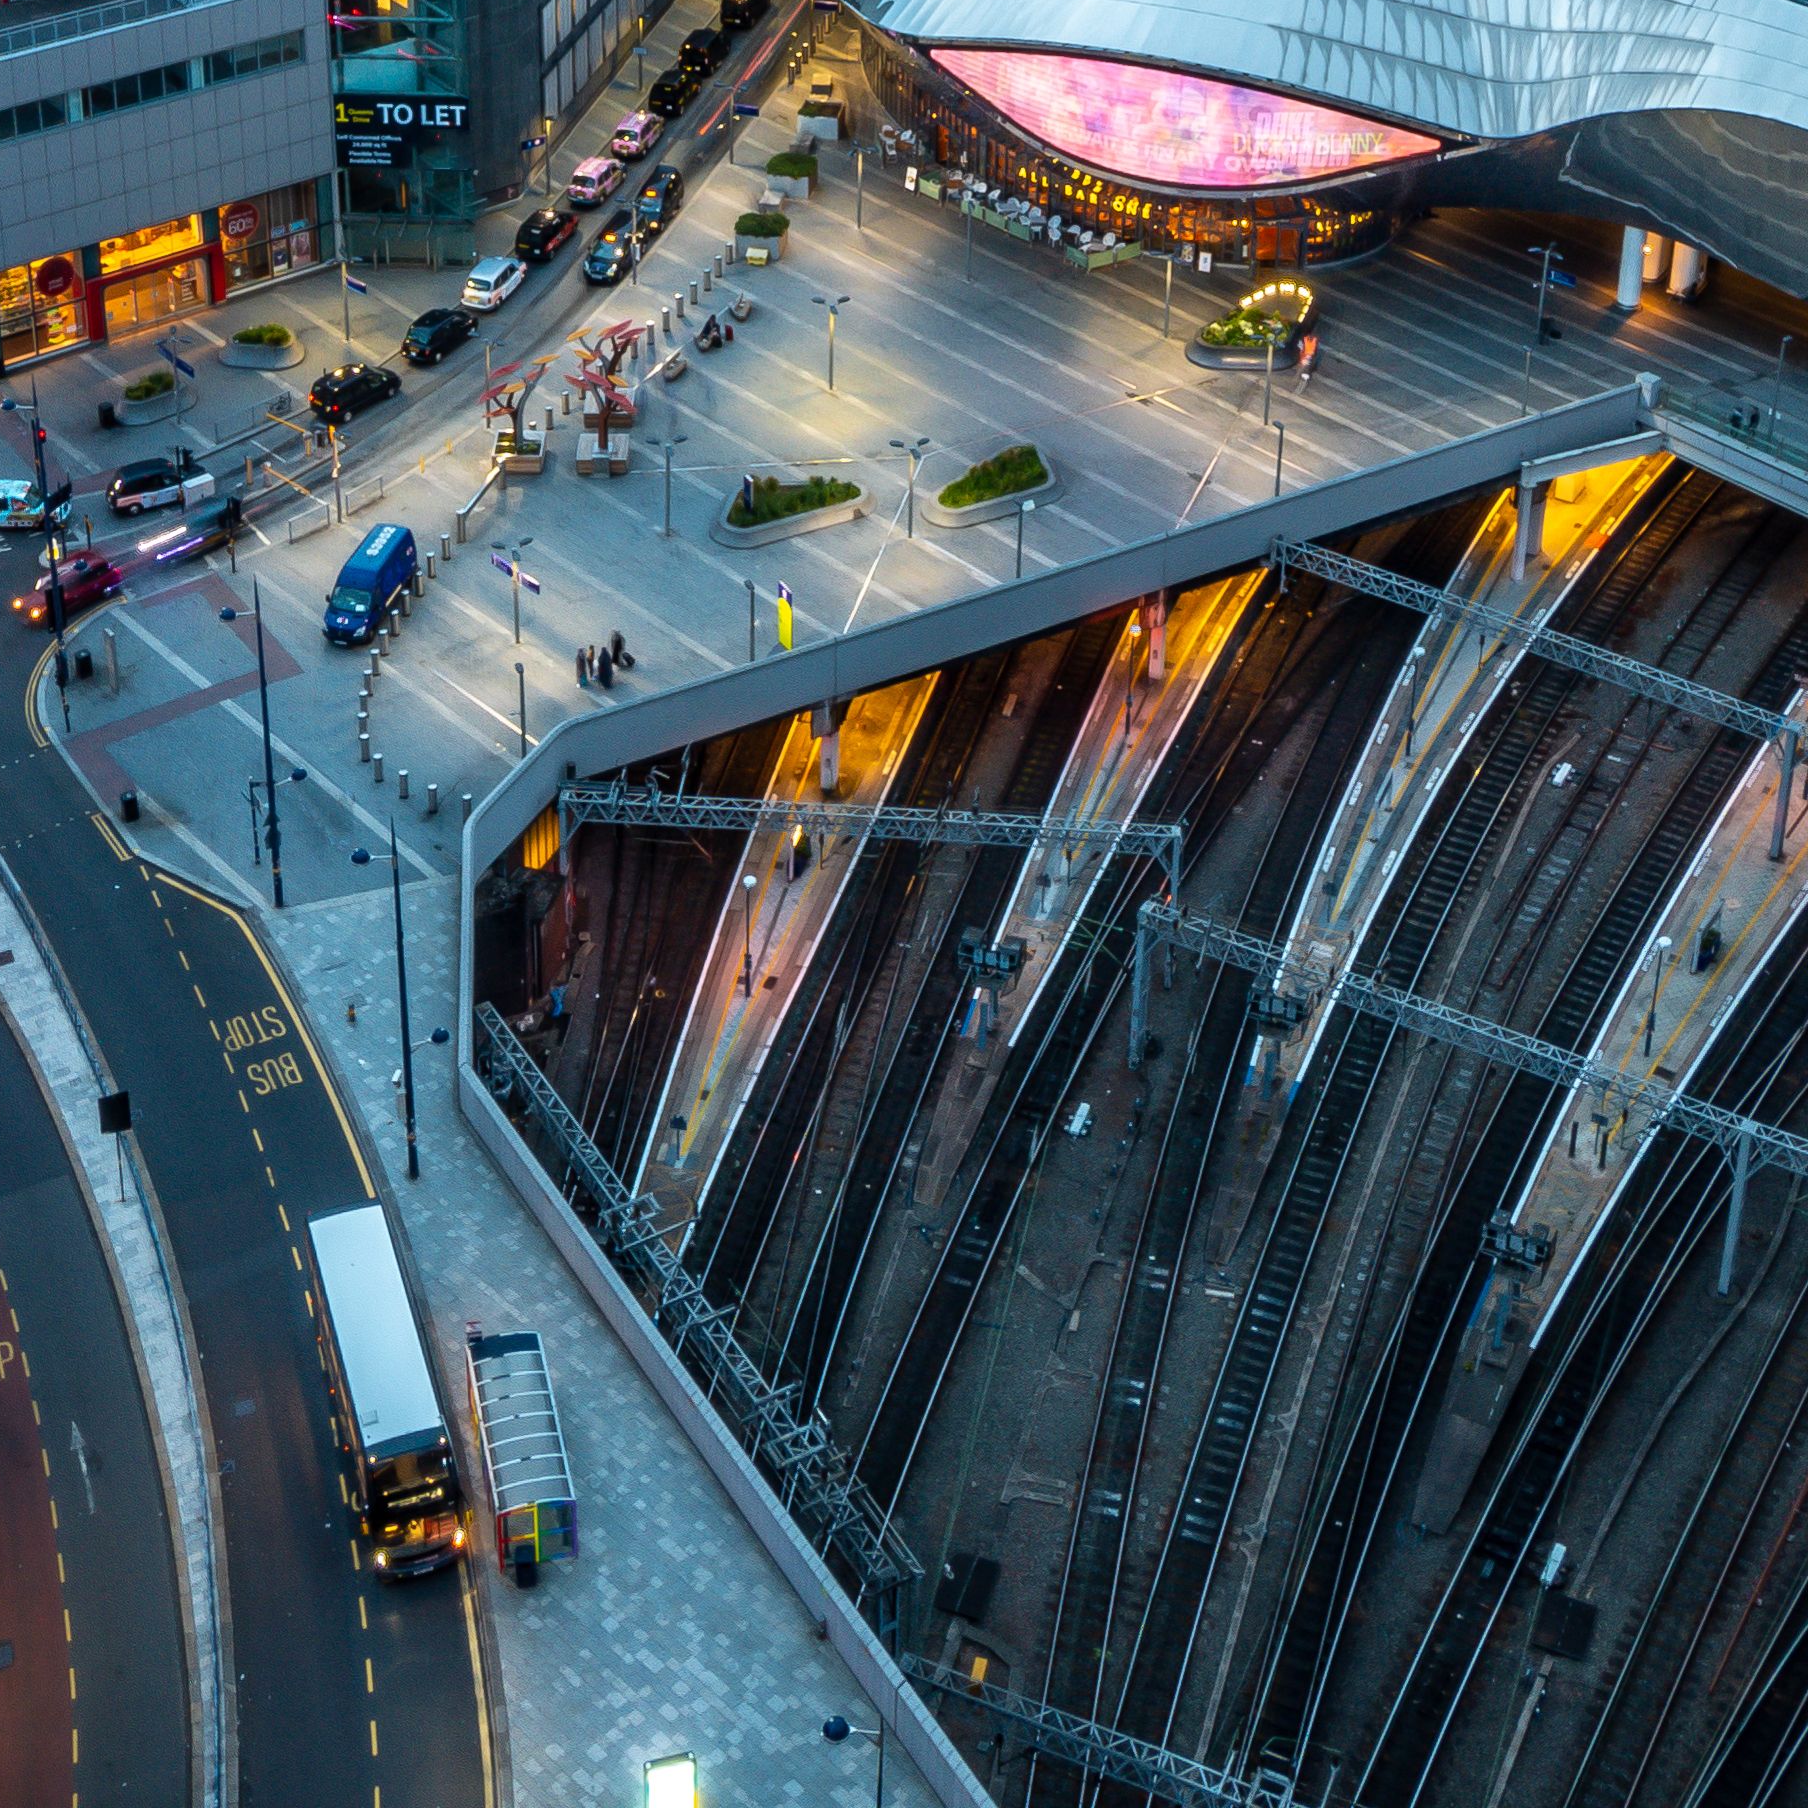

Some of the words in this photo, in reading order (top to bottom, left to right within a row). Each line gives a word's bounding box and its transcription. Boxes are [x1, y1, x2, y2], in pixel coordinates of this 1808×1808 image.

[335, 103, 349, 122] 1
[376, 103, 413, 125] TO
[420, 104, 466, 126] LET
[1018, 167, 1049, 188] ALL
[1064, 185, 1098, 205] BAR
[223, 1005, 288, 1054] STOP
[246, 1051, 304, 1096] BUS
